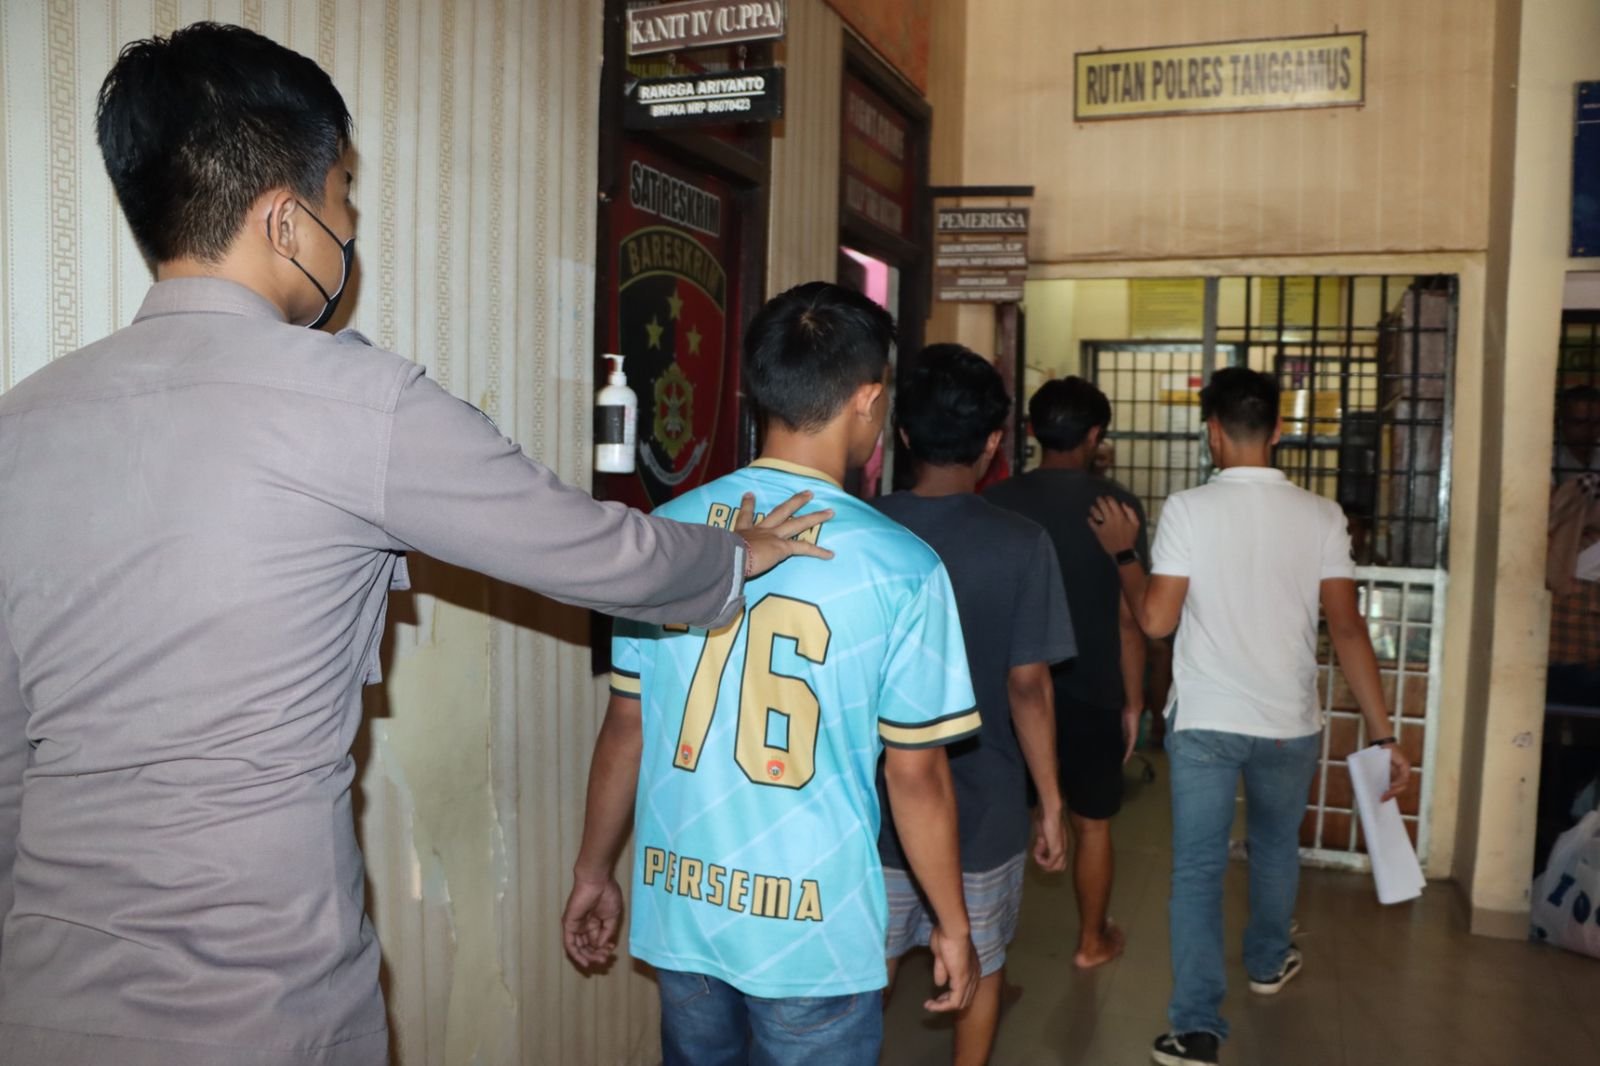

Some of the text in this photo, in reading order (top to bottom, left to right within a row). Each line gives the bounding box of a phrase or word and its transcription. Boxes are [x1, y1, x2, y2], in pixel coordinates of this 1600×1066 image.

[632, 12, 690, 44] KANIT
[690, 9, 713, 36] IV
[638, 76, 765, 100] RANGGA ARIYANTO
[1086, 46, 1352, 105] RUTAN POLRES TANGGAMUS
[937, 212, 1026, 230] PEMERIKSA
[626, 234, 720, 292] BARESKRIM
[643, 846, 824, 922] PERSEMA
